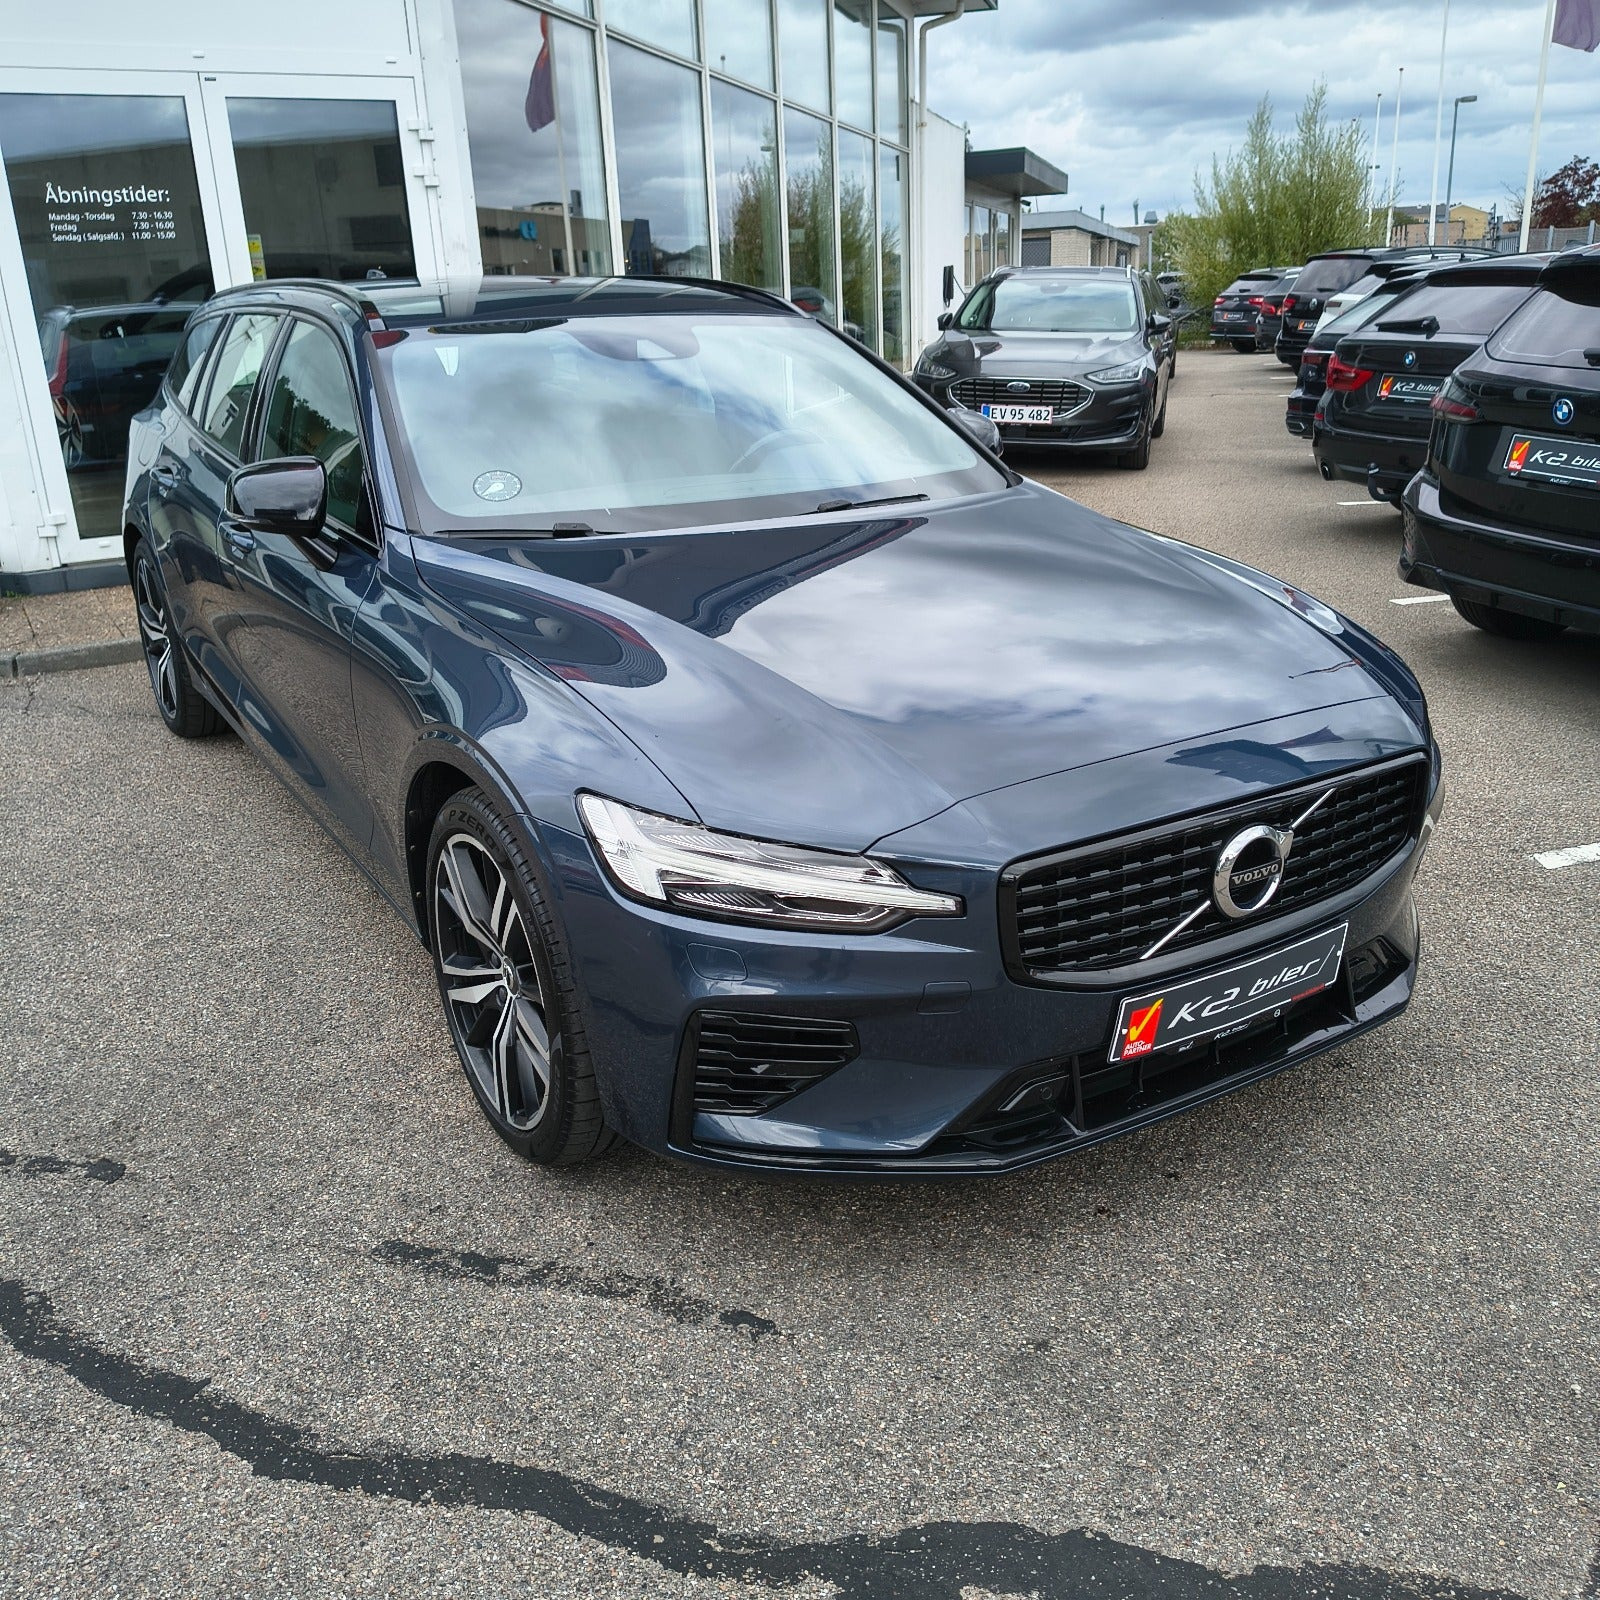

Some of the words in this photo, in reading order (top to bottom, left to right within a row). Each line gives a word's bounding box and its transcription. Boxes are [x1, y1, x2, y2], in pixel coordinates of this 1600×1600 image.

[45, 182, 170, 207] Åbningstider:
[48, 213, 80, 222] Mandag
[84, 212, 115, 222] Torsdag
[132, 211, 147, 219] 7.30
[50, 223, 77, 232] Fredag
[1392, 381, 1415, 391] K2
[991, 408, 1007, 419] EV
[1010, 408, 1024, 420] 95
[1028, 409, 1050, 421] 482
[1529, 449, 1568, 466] K2
[448, 809, 457, 822] P
[1231, 863, 1279, 885] VOLVO
[1167, 987, 1240, 1029] K2
[1248, 958, 1320, 996] biler
